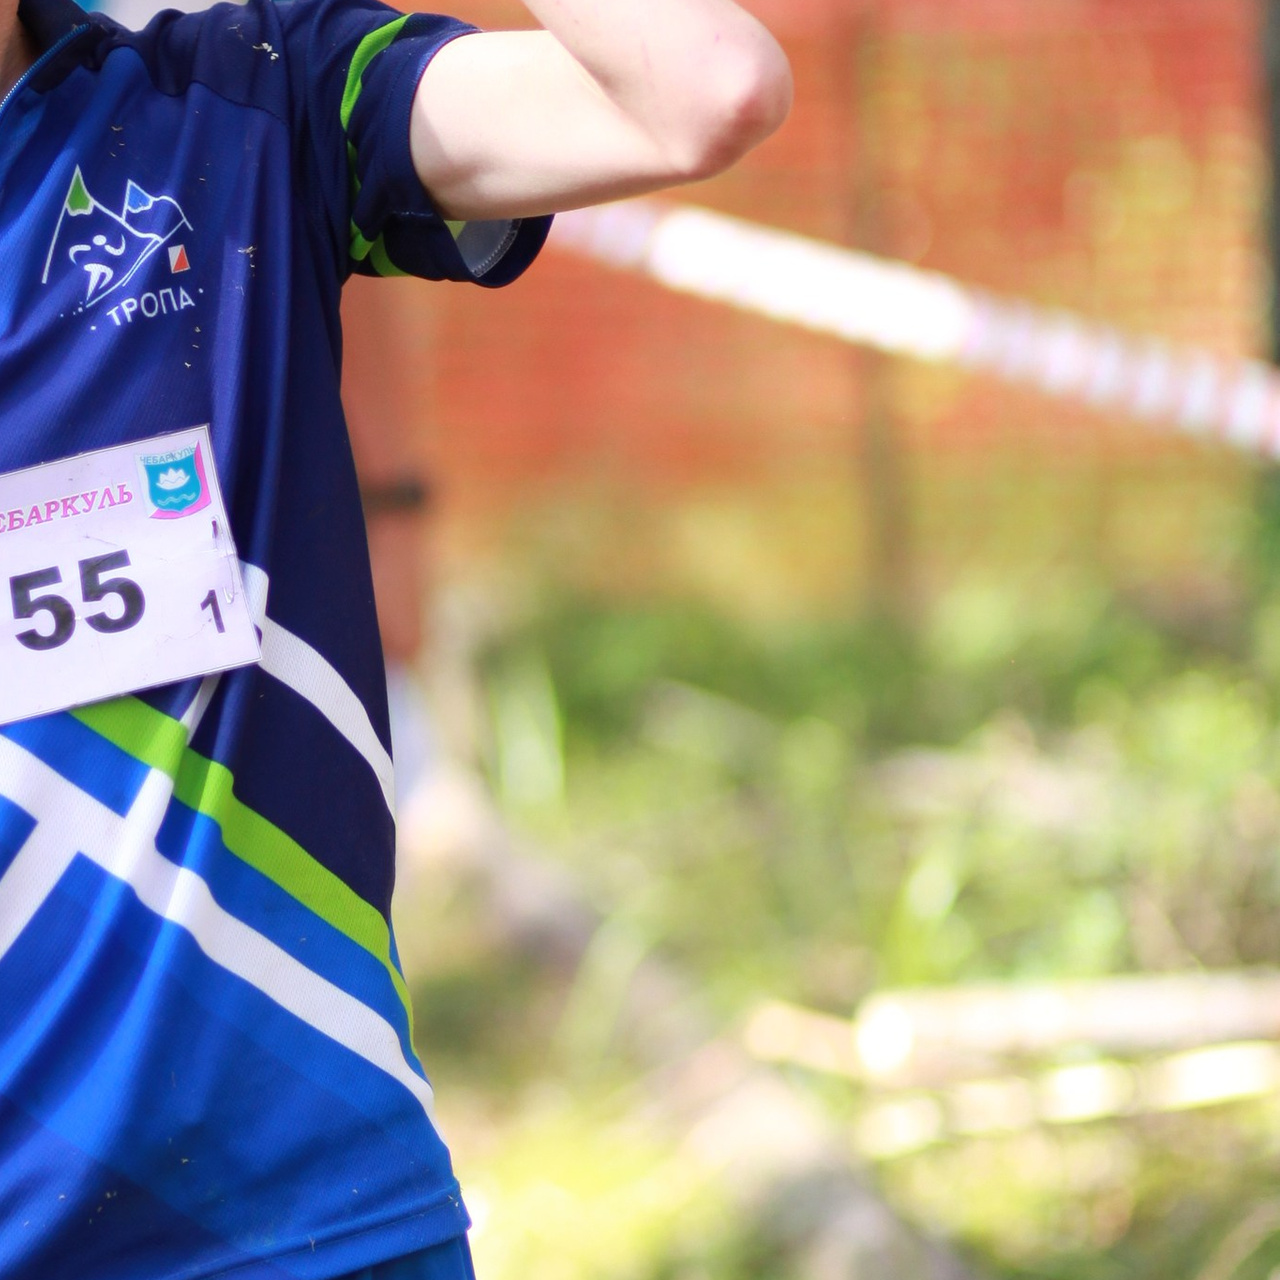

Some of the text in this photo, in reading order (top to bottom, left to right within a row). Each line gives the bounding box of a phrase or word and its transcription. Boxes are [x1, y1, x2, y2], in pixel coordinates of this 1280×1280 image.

[106, 286, 195, 326] ТРОПА
[140, 446, 196, 464] ЧЕБАРКУЛЬ
[9, 549, 146, 651] 55
[200, 589, 226, 634] 1
